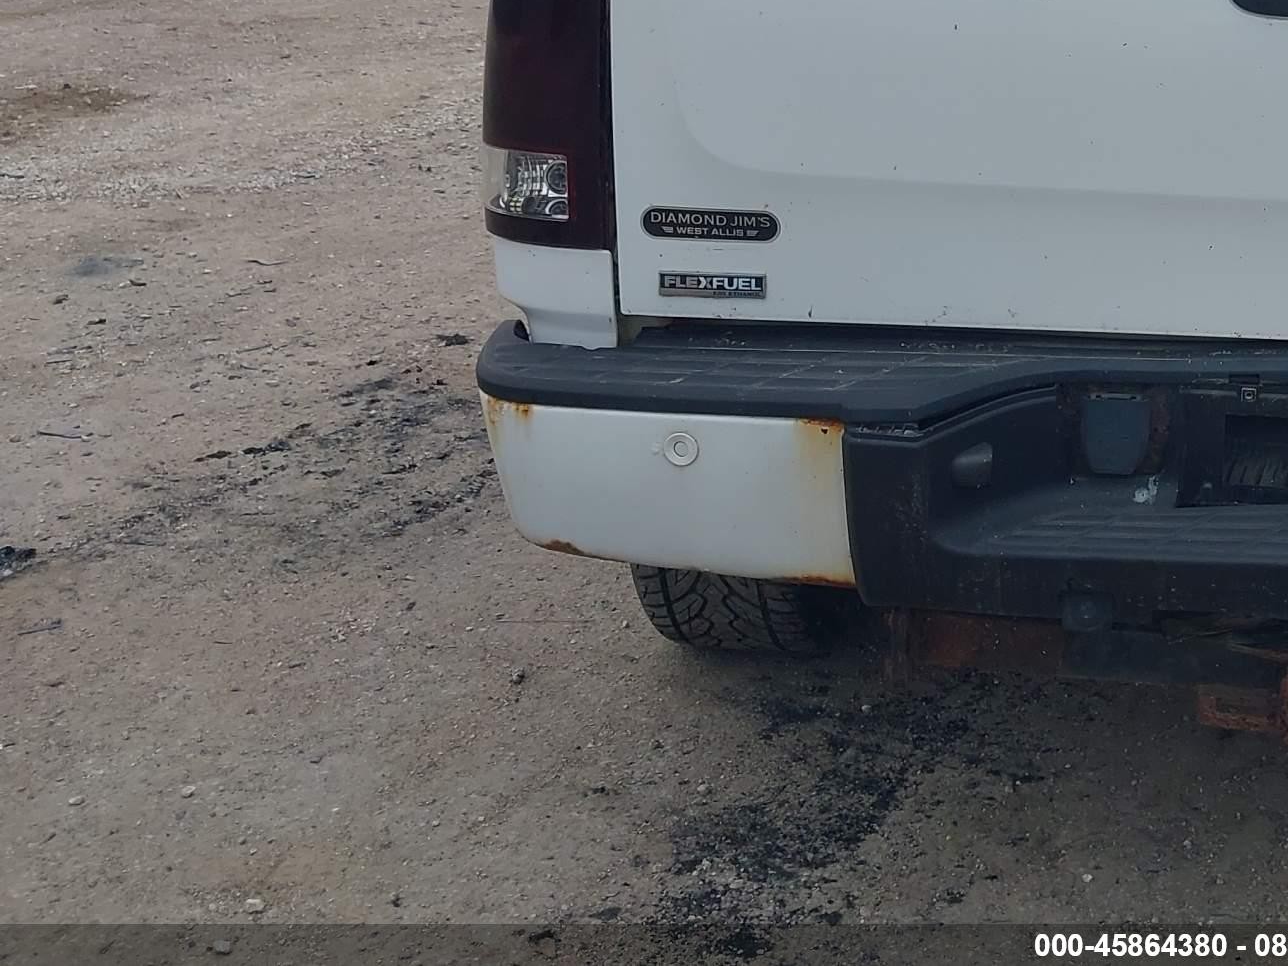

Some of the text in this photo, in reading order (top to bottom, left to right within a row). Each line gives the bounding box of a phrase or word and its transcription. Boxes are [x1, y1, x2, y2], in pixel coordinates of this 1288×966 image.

[650, 211, 770, 227] DIAMOND JIM'S
[676, 226, 743, 237] WEST ALLIS
